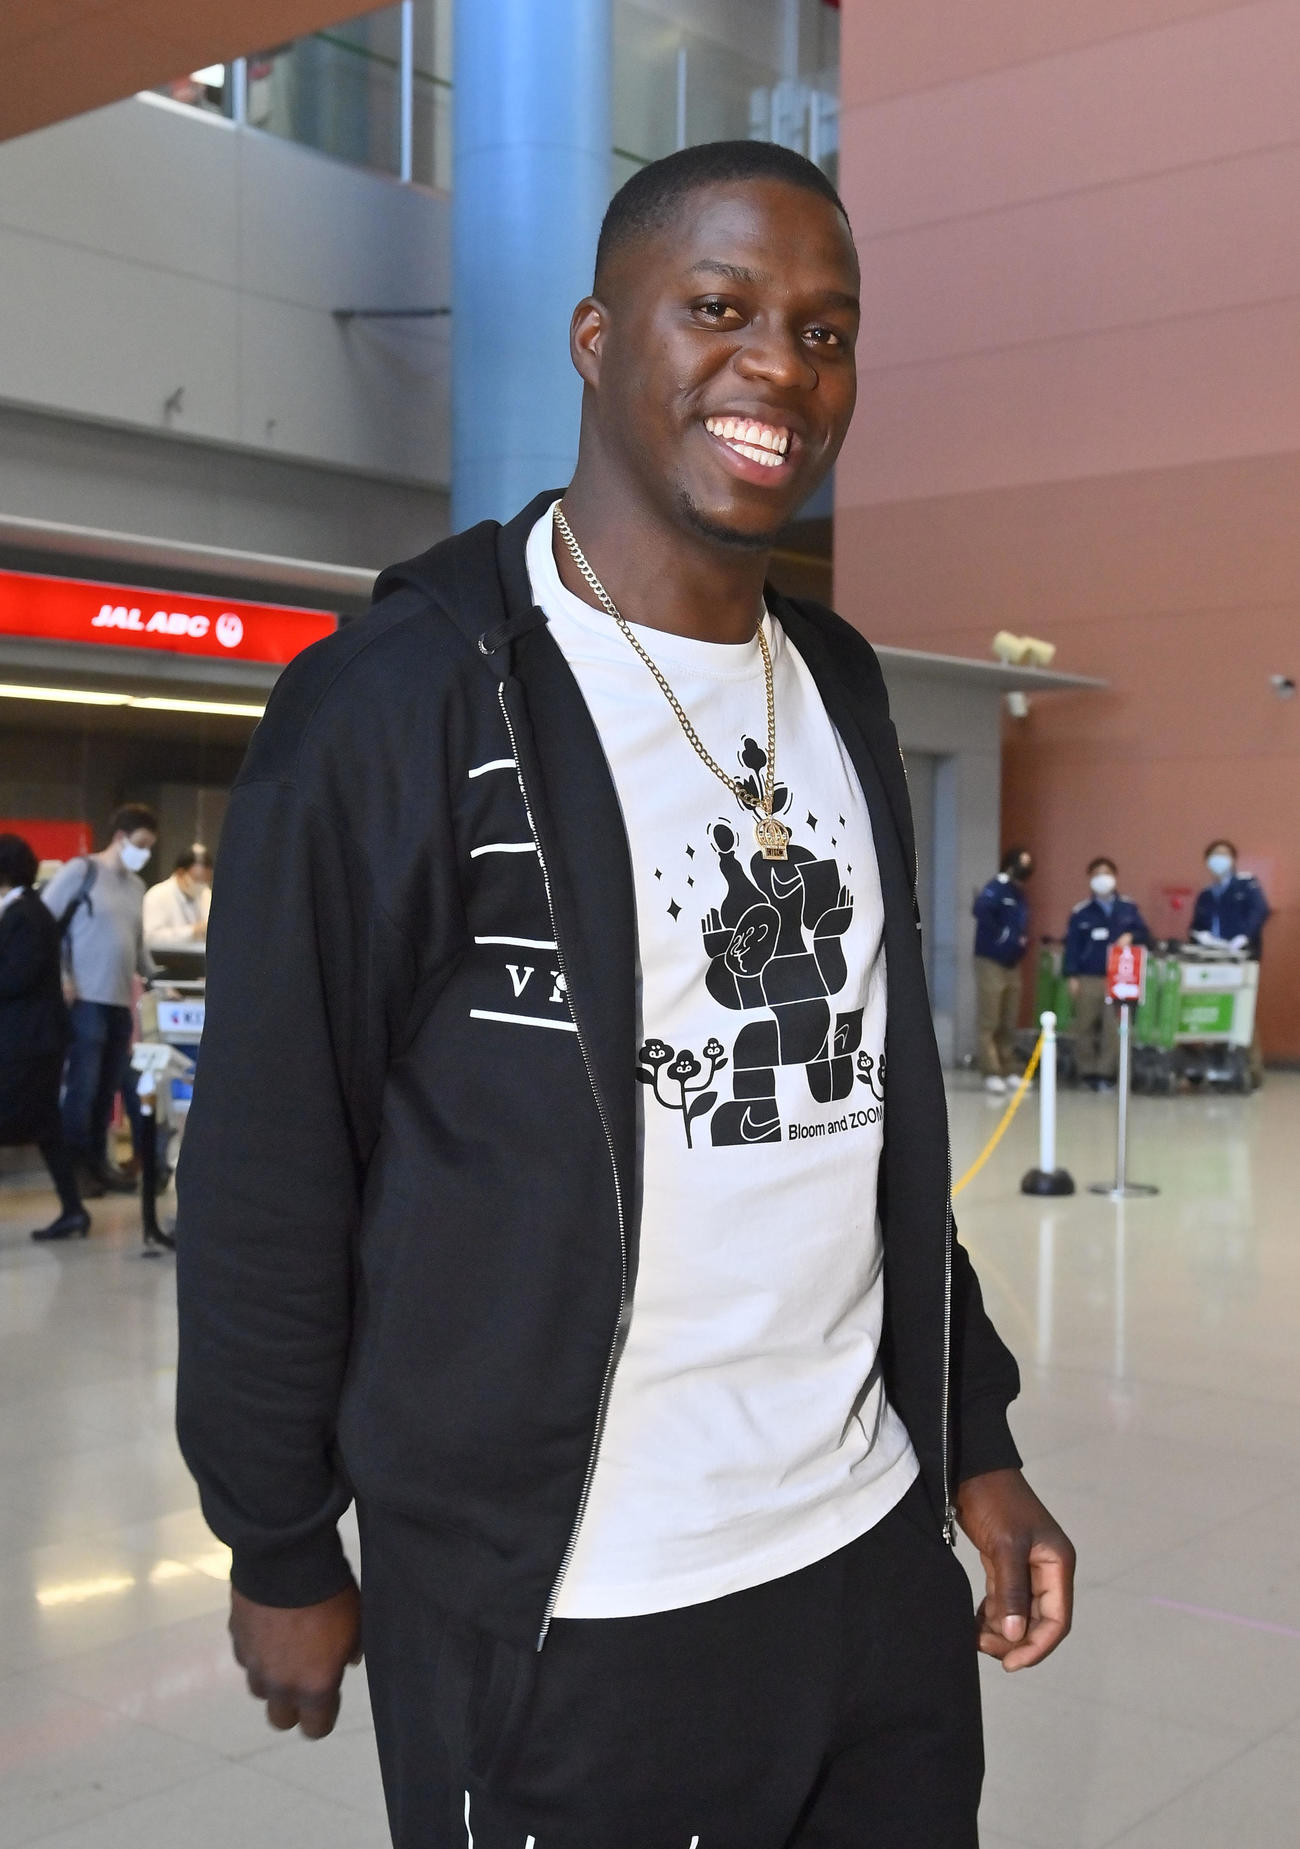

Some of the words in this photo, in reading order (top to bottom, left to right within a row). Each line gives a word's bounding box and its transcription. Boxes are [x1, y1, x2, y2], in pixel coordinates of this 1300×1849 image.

[91, 605, 144, 631] JAL
[146, 611, 210, 637] ABC
[788, 1123, 826, 1141] Bloom
[827, 1115, 849, 1135] and
